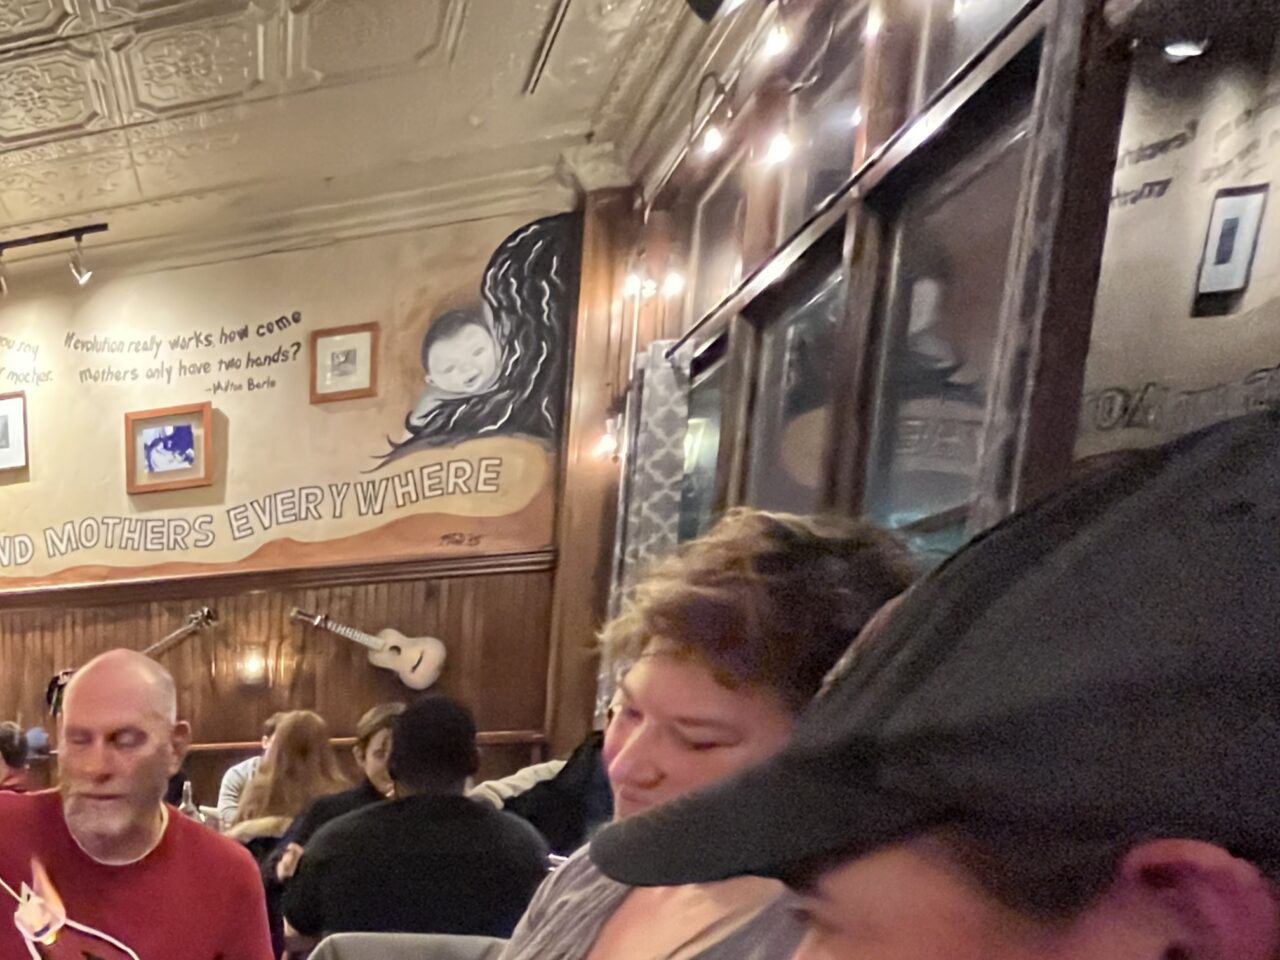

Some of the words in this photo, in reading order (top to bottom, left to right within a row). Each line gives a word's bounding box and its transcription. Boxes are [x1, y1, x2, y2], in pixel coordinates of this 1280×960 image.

[18, 341, 40, 363] say
[73, 334, 125, 353] evolution
[127, 335, 162, 360] really
[219, 326, 249, 345] how
[255, 310, 302, 338] come
[79, 365, 139, 384] mothers
[145, 364, 173, 385] only
[178, 359, 212, 377] have
[218, 356, 242, 371] two
[245, 341, 303, 370] hands?
[43, 515, 215, 559] MOTHERS
[226, 457, 503, 541] EVERYWHERE
